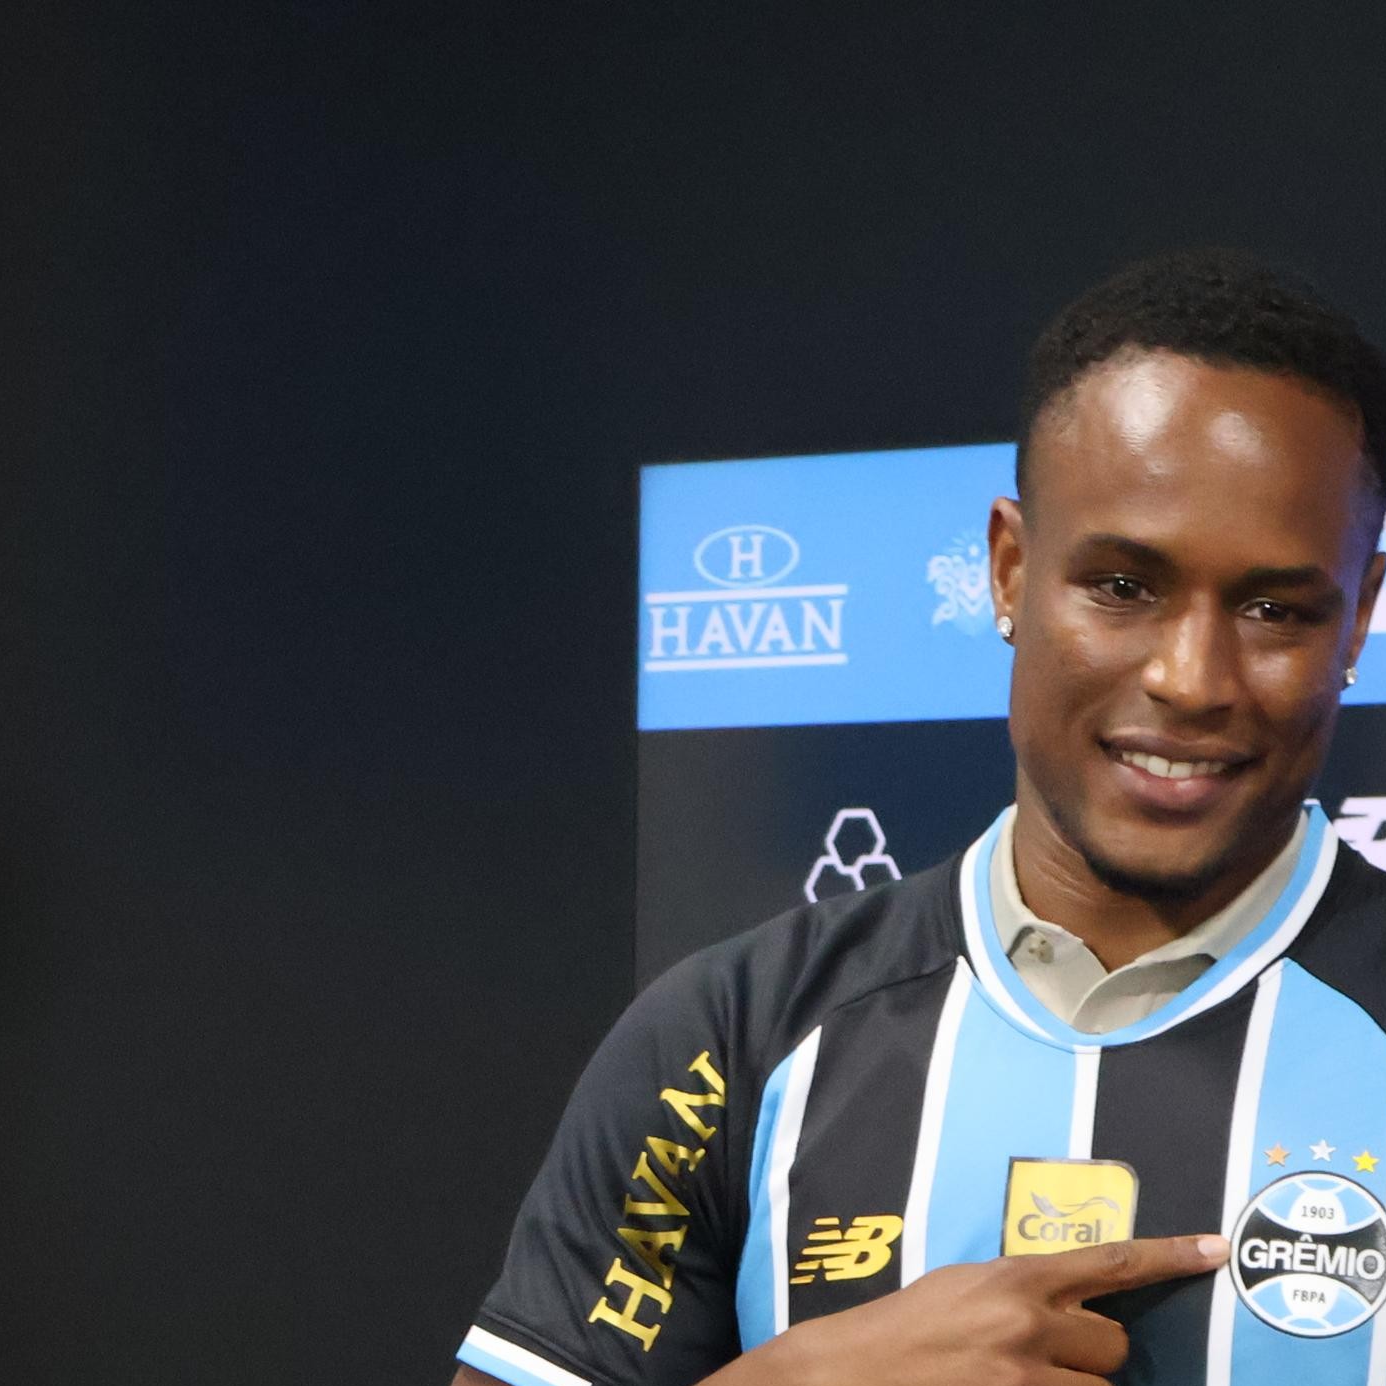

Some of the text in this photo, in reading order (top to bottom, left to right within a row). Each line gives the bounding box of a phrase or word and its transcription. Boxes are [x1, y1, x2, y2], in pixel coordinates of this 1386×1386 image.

[728, 534, 763, 579] H
[648, 599, 845, 657] HAVAN
[587, 1050, 726, 1353] HAVAN
[1300, 1205, 1336, 1221] 1903
[1017, 1213, 1102, 1244] Coral
[1239, 1233, 1386, 1281] GRÊMIO
[1292, 1289, 1327, 1304] FBPA
